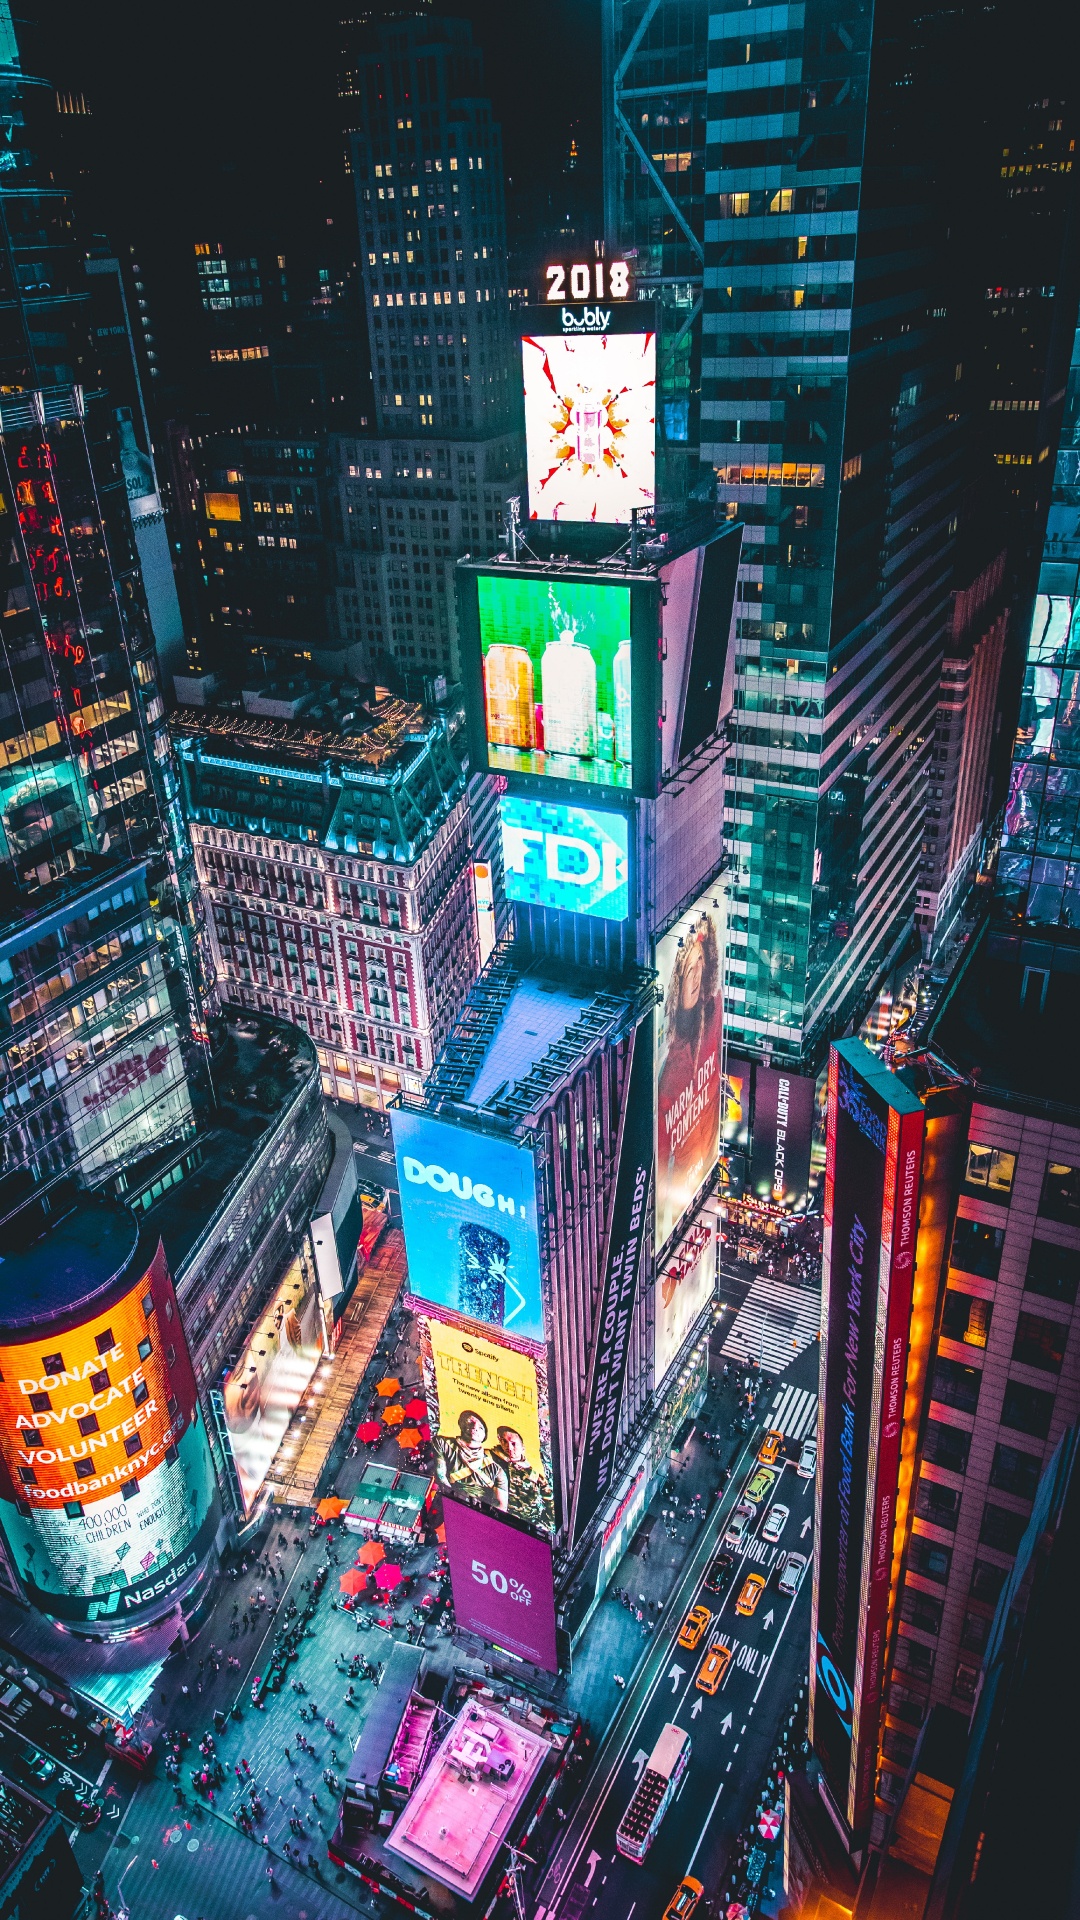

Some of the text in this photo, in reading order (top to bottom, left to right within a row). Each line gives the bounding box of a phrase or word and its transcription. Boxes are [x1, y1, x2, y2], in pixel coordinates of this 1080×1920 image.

[546, 261, 629, 300] 2018
[561, 306, 611, 330] bubly
[665, 1080, 695, 1134] WARM.
[697, 1051, 716, 1091] DRY.
[777, 1101, 789, 1127] DUTY
[775, 1129, 786, 1168] BLACK
[773, 1169, 784, 1192] OPS
[900, 1150, 916, 1247] THOMSON REUTERS
[850, 1214, 868, 1265] City
[621, 1236, 639, 1302] TWIN
[847, 1264, 863, 1316] York
[475, 1348, 499, 1362] Spotify
[600, 1346, 612, 1364] A
[611, 1305, 629, 1378] WANT
[843, 1321, 860, 1370] New
[18, 1342, 125, 1395] DONATE
[437, 1351, 533, 1405] TRENCH
[452, 1377, 520, 1410] The new album from
[842, 1366, 858, 1407] For
[888, 1337, 902, 1419] THOMSON REUTERS
[15, 1366, 146, 1429] ADVOCATE
[458, 1388, 481, 1401] twenty
[602, 1381, 620, 1450] DON'T
[17, 1400, 159, 1465] VOLUNTEER
[840, 1402, 855, 1458] Bank
[24, 1412, 185, 1499] foodbanknyc.org
[597, 1452, 610, 1492] WE
[838, 1448, 853, 1507] Food
[79, 1503, 128, 1530] 400,000
[86, 1518, 132, 1544] CHILDREN
[877, 1495, 891, 1565] THOMSON REUTERS
[748, 1540, 779, 1567] ONLY
[124, 1552, 197, 1609] Nasdaq
[471, 1559, 532, 1600] 50%
[510, 1591, 532, 1607] OFF
[737, 1645, 769, 1678] ONLY
[869, 1629, 881, 1690] THOMSON REUTERS
